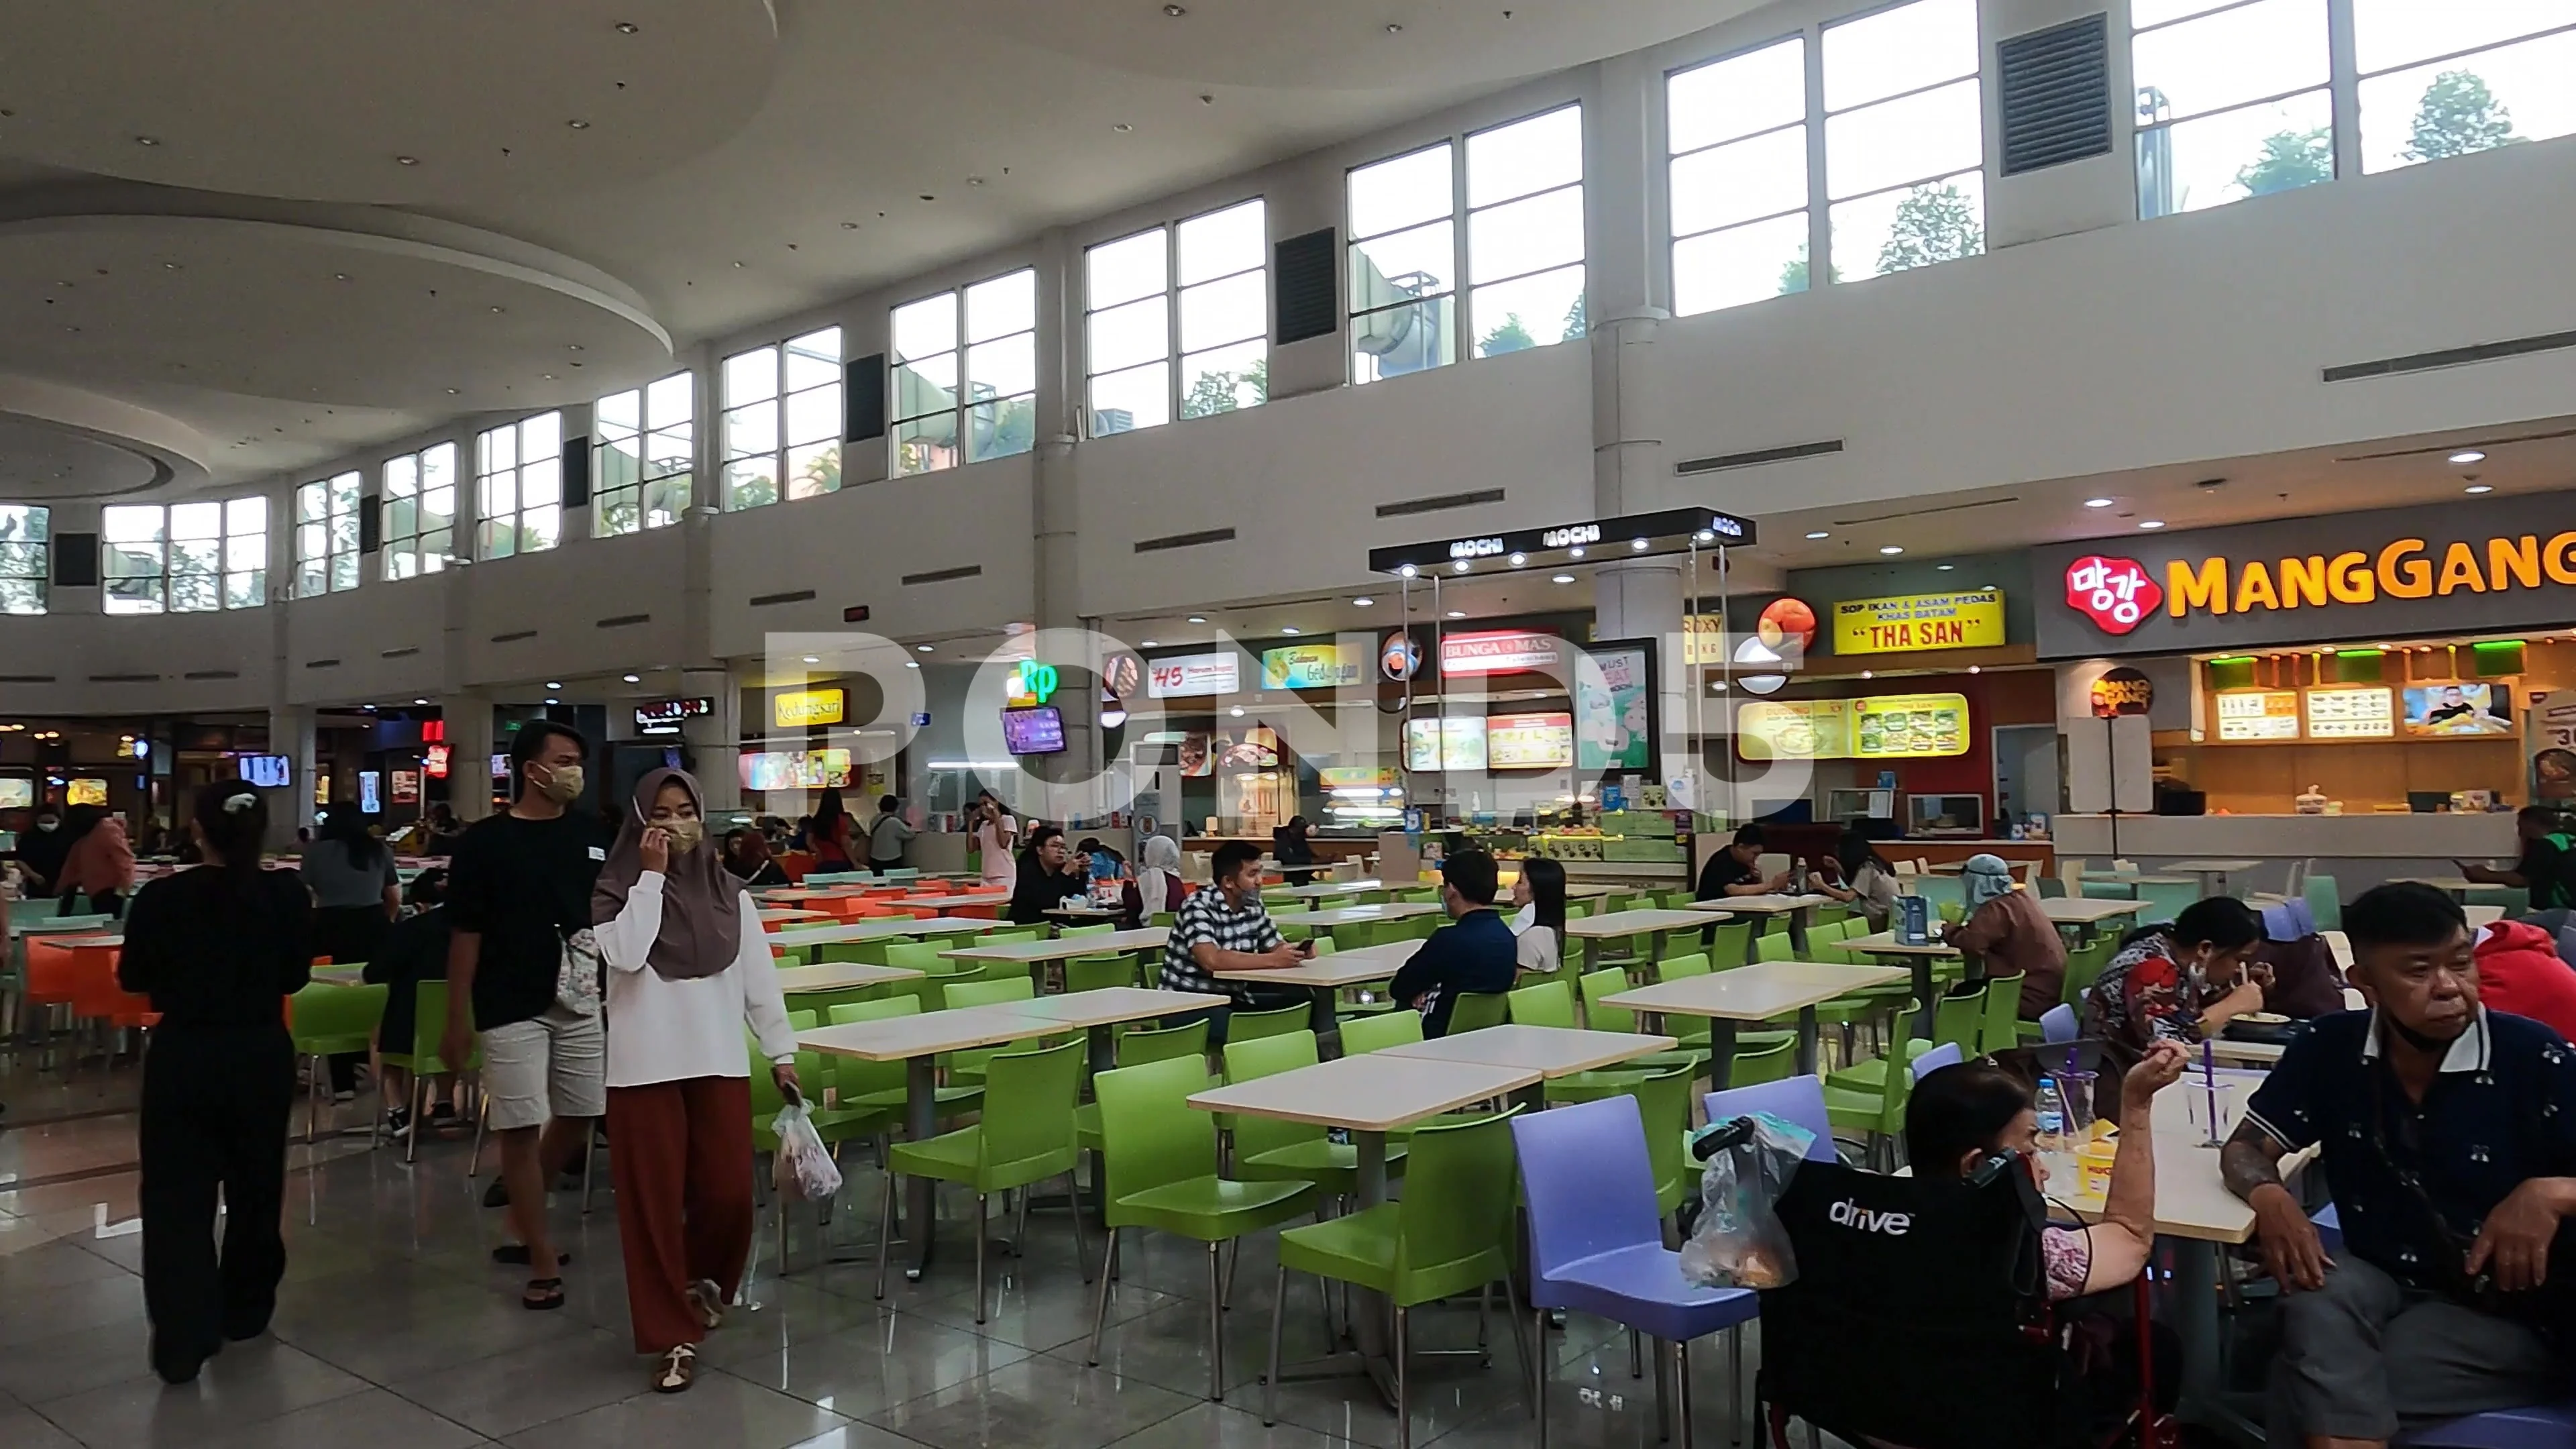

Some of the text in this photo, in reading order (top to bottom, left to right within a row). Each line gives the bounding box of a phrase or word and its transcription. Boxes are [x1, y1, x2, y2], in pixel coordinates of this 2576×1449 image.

[1543, 525, 1601, 547] MOCHI
[1450, 537, 1504, 557] MOCHI
[1841, 604, 1865, 614] SOP
[1954, 593, 1996, 604] PEDAS
[1445, 637, 1552, 657] BUNGA MAS
[1829, 1197, 1911, 1236] drive
